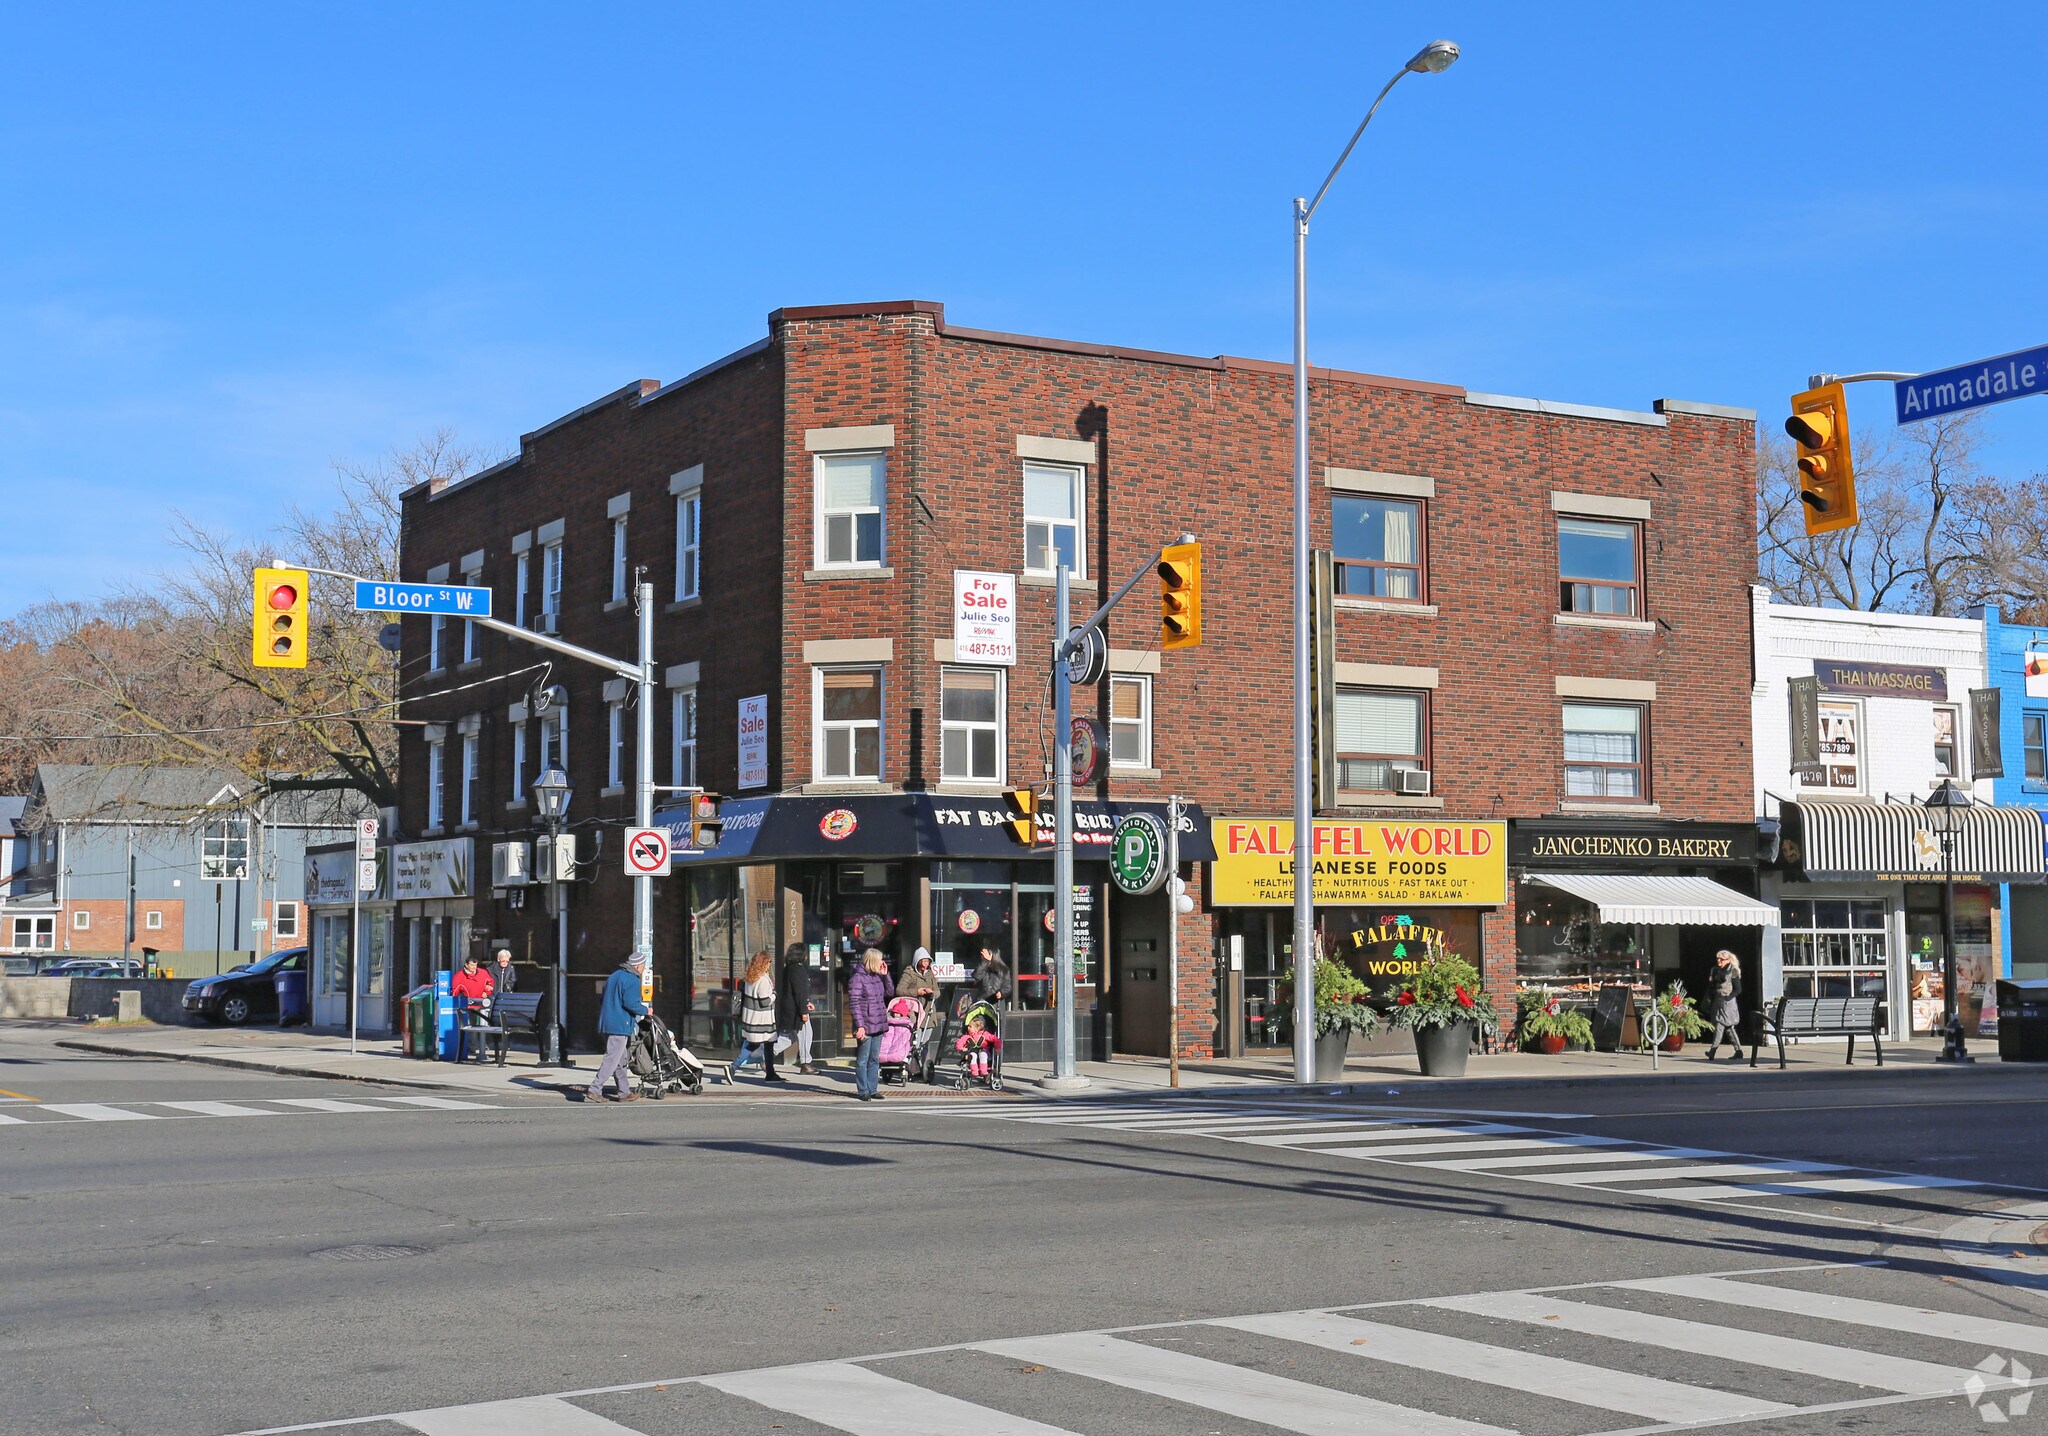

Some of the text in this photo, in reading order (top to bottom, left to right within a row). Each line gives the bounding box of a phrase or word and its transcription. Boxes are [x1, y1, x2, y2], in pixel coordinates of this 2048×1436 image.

[1904, 361, 2037, 415] Armadale
[973, 579, 998, 591] For
[374, 586, 472, 610] Bloor St W
[963, 591, 1008, 609] Sale
[960, 611, 1011, 623] Julie Seo
[969, 643, 1012, 656] 487-5131
[1794, 681, 1813, 693] THAI
[1831, 668, 1932, 690] THAI MASSAGE
[1975, 692, 1996, 703] THAI
[746, 702, 759, 713] For
[740, 715, 765, 734] Sale
[1799, 693, 1809, 757] MASSAGE
[740, 734, 765, 746] Julie Seo
[1981, 705, 1991, 765] MASSAGE
[1818, 742, 1851, 753] 85.7889
[1832, 767, 1855, 785] ไทย
[934, 808, 972, 826] FAT
[978, 810, 1055, 828] BASAR
[1073, 831, 1090, 842] Go
[1113, 820, 1157, 846] MUNICIPAL
[1227, 823, 1492, 856] FALFEL WORLD
[1124, 835, 1145, 865] P
[1532, 836, 1732, 858] JANCHENKO BAKERY
[1112, 860, 1157, 888] PARKING
[1279, 861, 1447, 875] LEANESE FOODS
[1253, 878, 1294, 887] HEALTHY
[1333, 879, 1390, 887] NUTRITIOUS
[1399, 879, 1421, 887] FAST
[1425, 879, 1447, 887] TAKE
[1450, 879, 1468, 887] OUT
[1259, 890, 1295, 899] FALAFE
[1377, 890, 1408, 899] SALAD
[1419, 890, 1463, 899] BAKLAWA
[932, 964, 955, 977] SKIP
[1368, 960, 1429, 976] WORL
